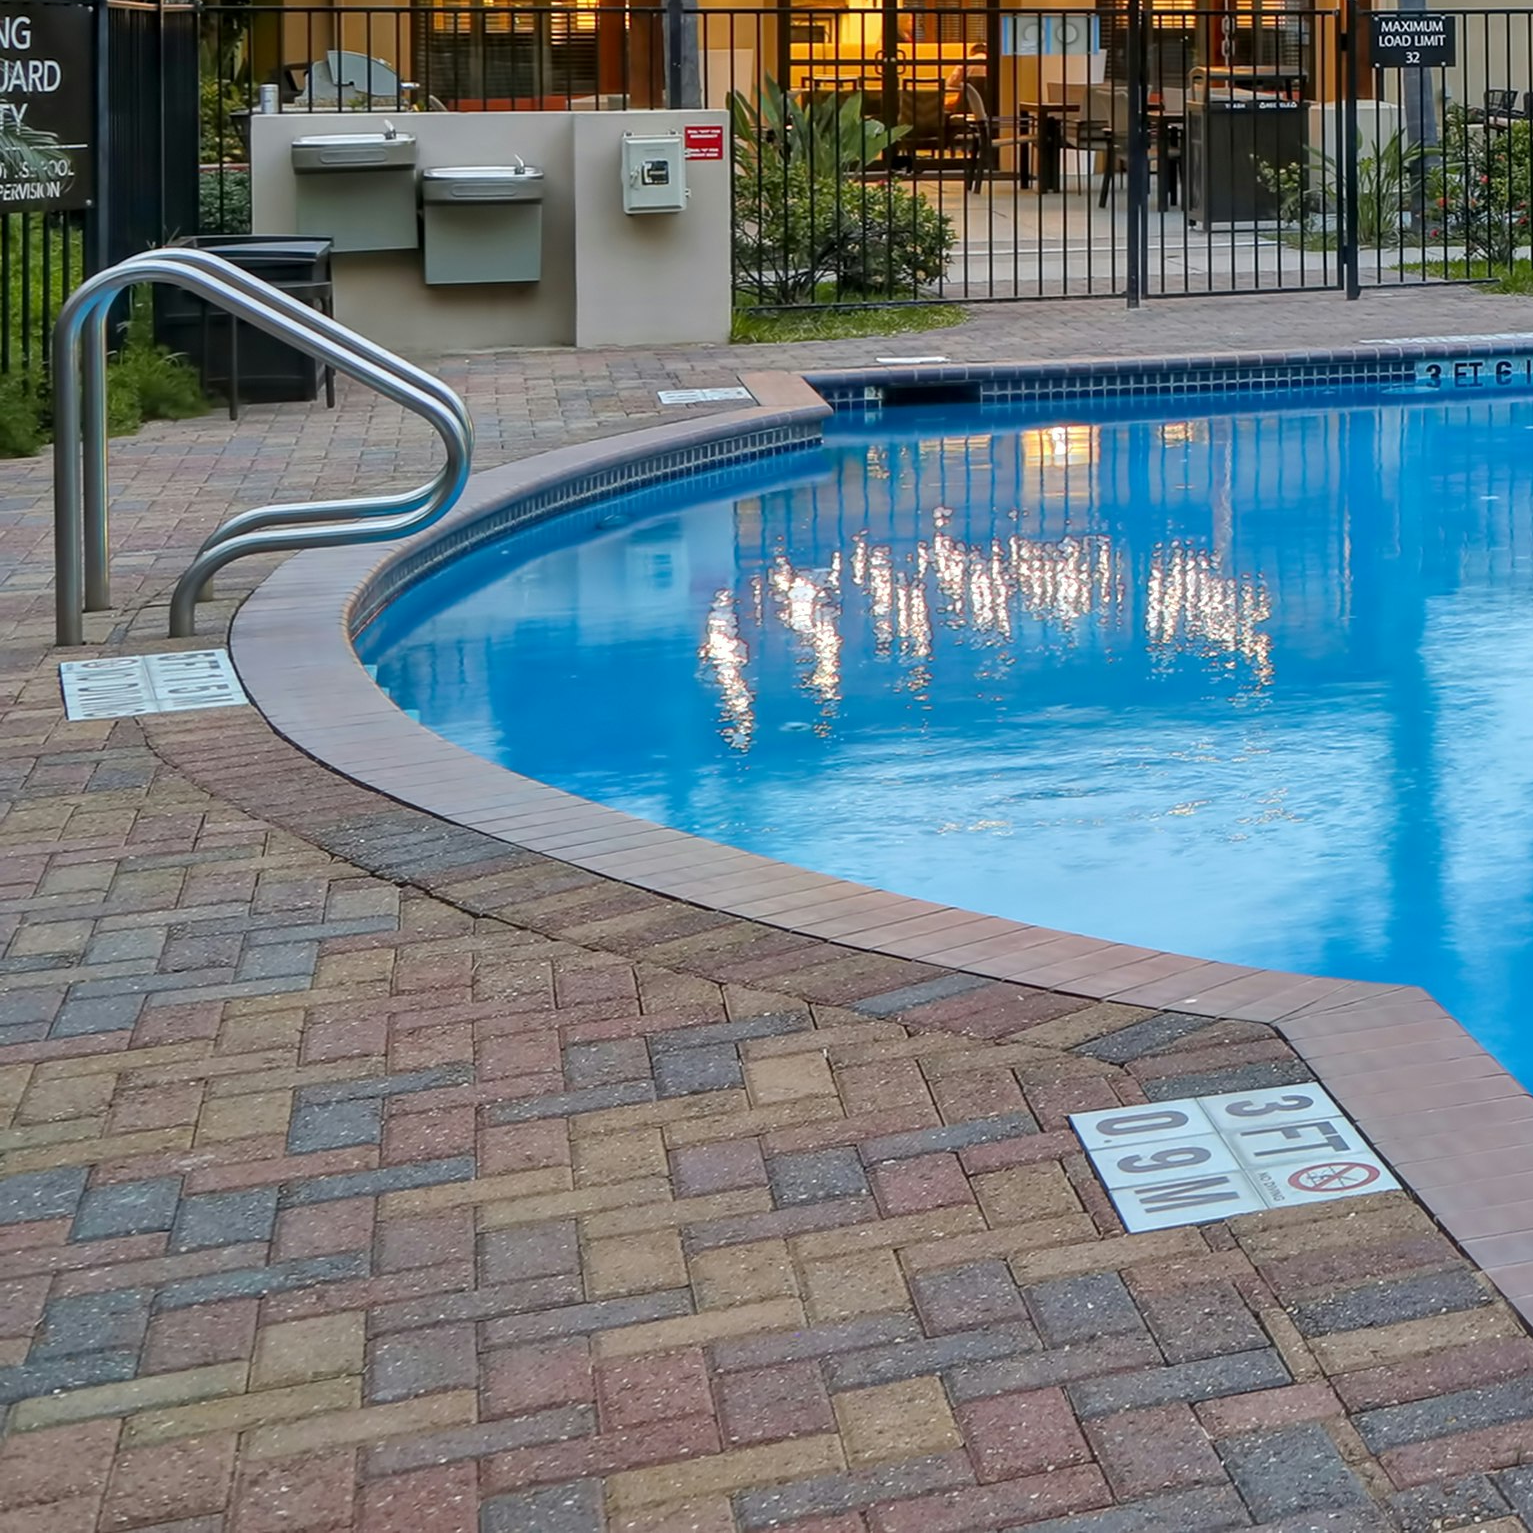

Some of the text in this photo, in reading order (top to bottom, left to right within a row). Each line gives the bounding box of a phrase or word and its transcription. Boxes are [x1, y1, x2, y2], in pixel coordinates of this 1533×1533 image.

[1380, 21, 1444, 32] MAXIMUM
[1378, 35, 1446, 47] LOAD LIMIT
[1405, 51, 1420, 64] 32
[1225, 1094, 1351, 1157] 3 FT
